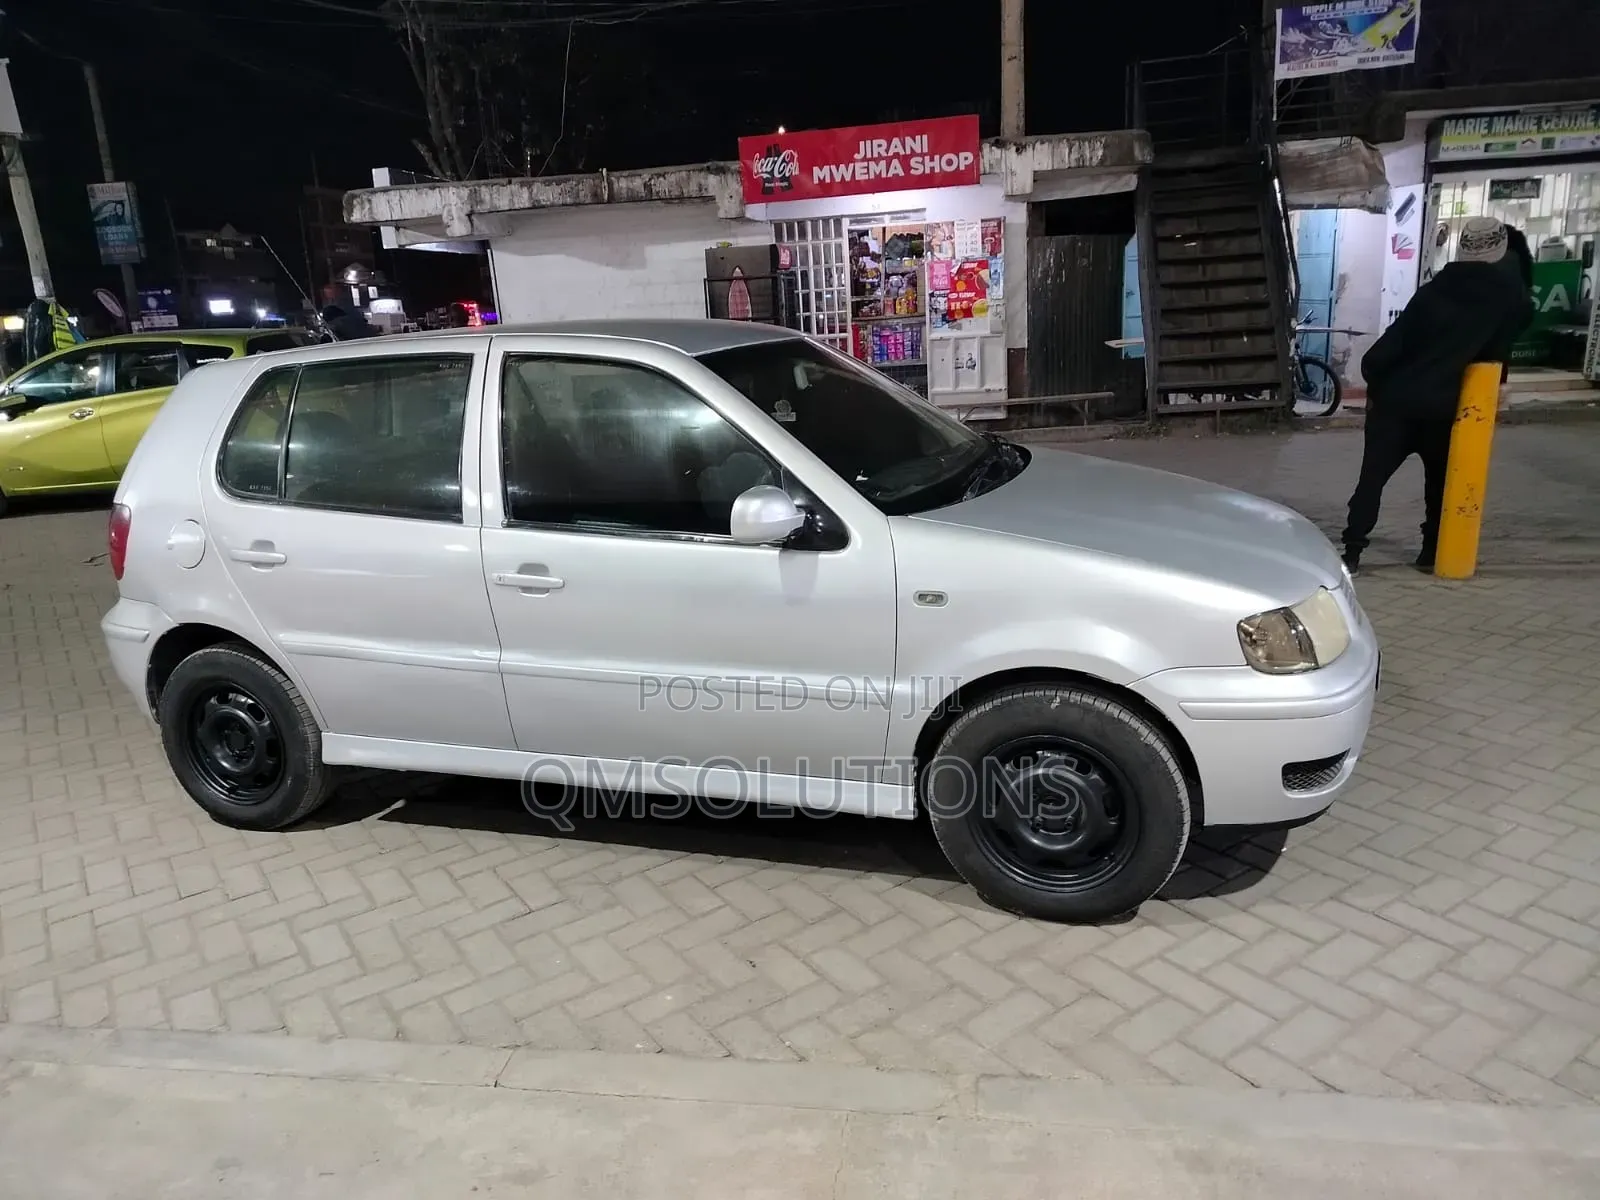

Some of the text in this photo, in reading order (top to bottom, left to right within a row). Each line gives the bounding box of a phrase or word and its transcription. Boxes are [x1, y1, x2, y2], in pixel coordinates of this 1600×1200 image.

[1443, 117, 1490, 136] MARIE
[853, 134, 929, 160] JIRANI
[812, 151, 974, 185] MWEMA SHOP
